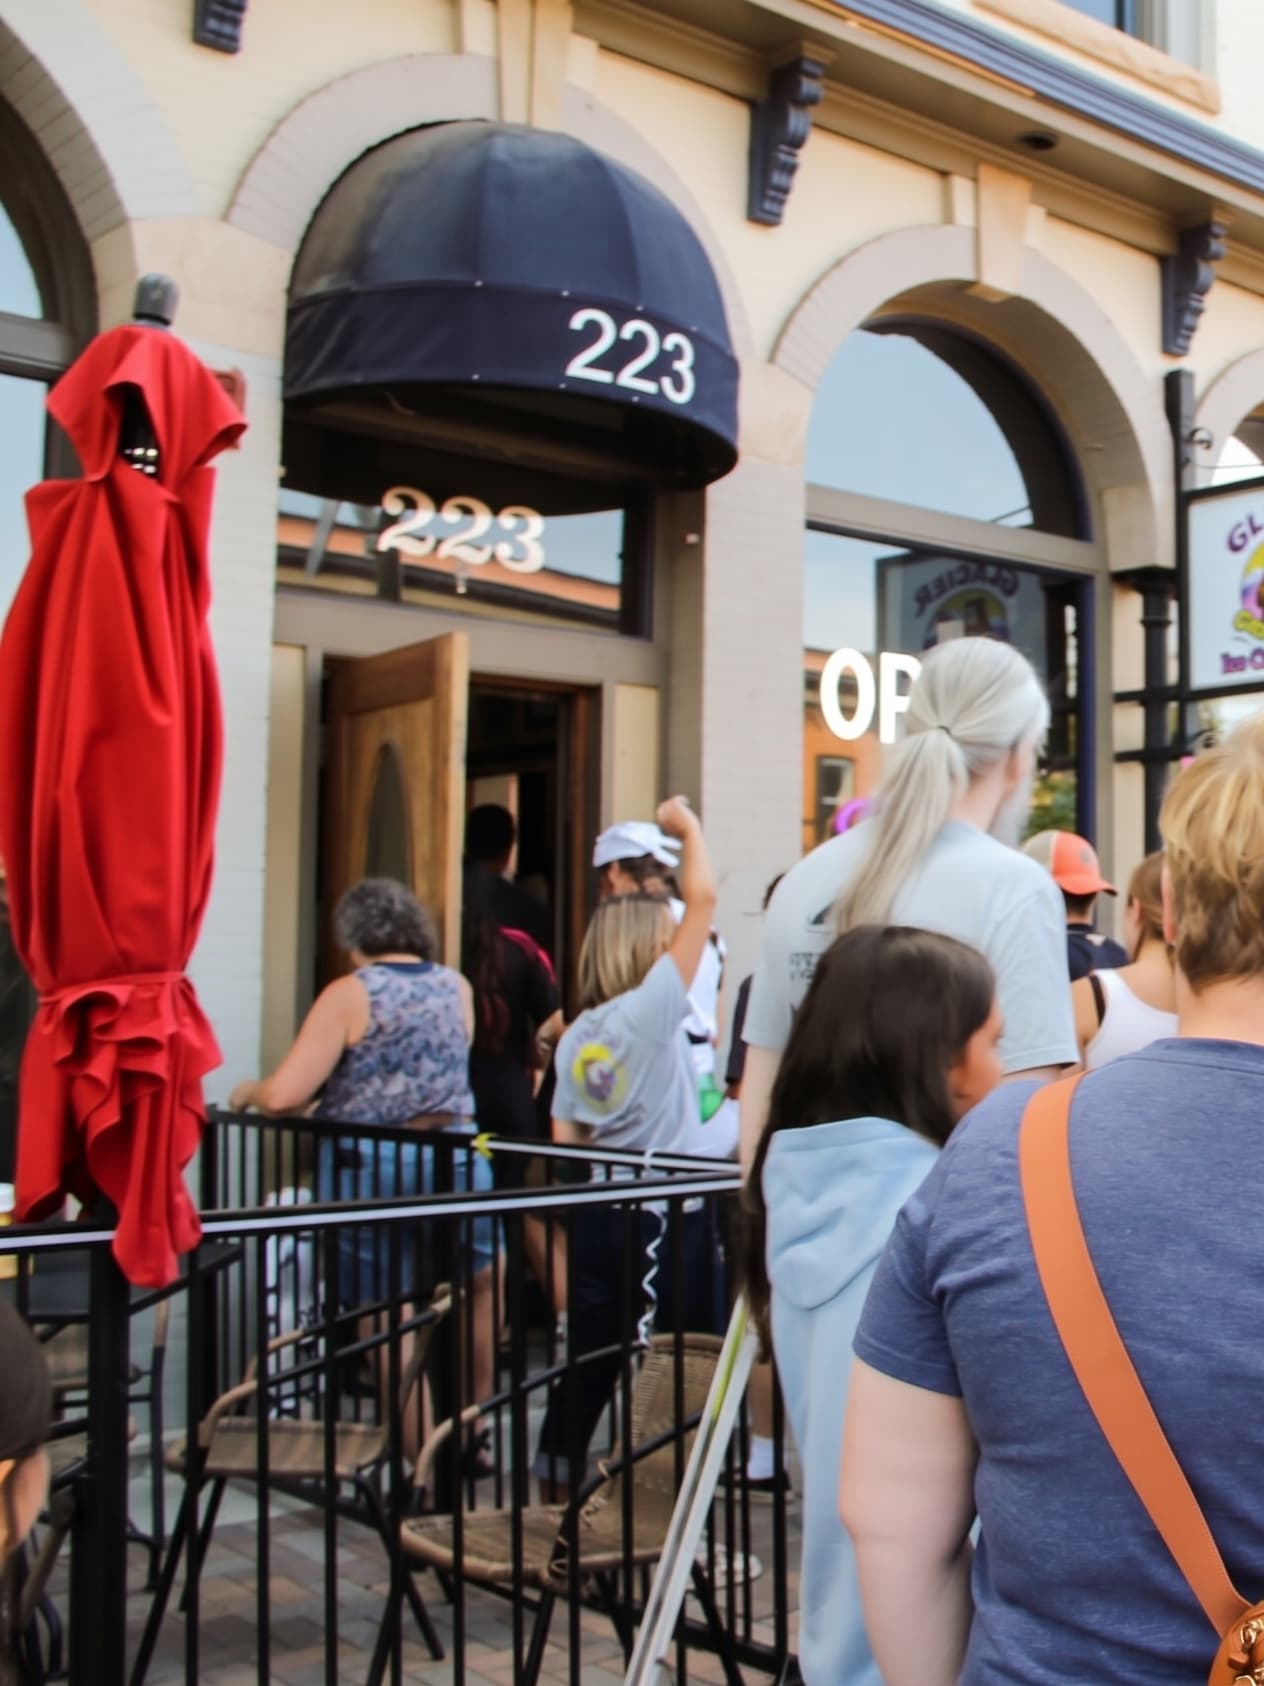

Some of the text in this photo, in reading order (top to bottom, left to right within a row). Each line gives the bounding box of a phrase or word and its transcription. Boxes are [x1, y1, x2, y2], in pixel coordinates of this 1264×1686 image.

[565, 308, 696, 405] 223
[377, 485, 546, 575] 223
[820, 647, 923, 745] OP
